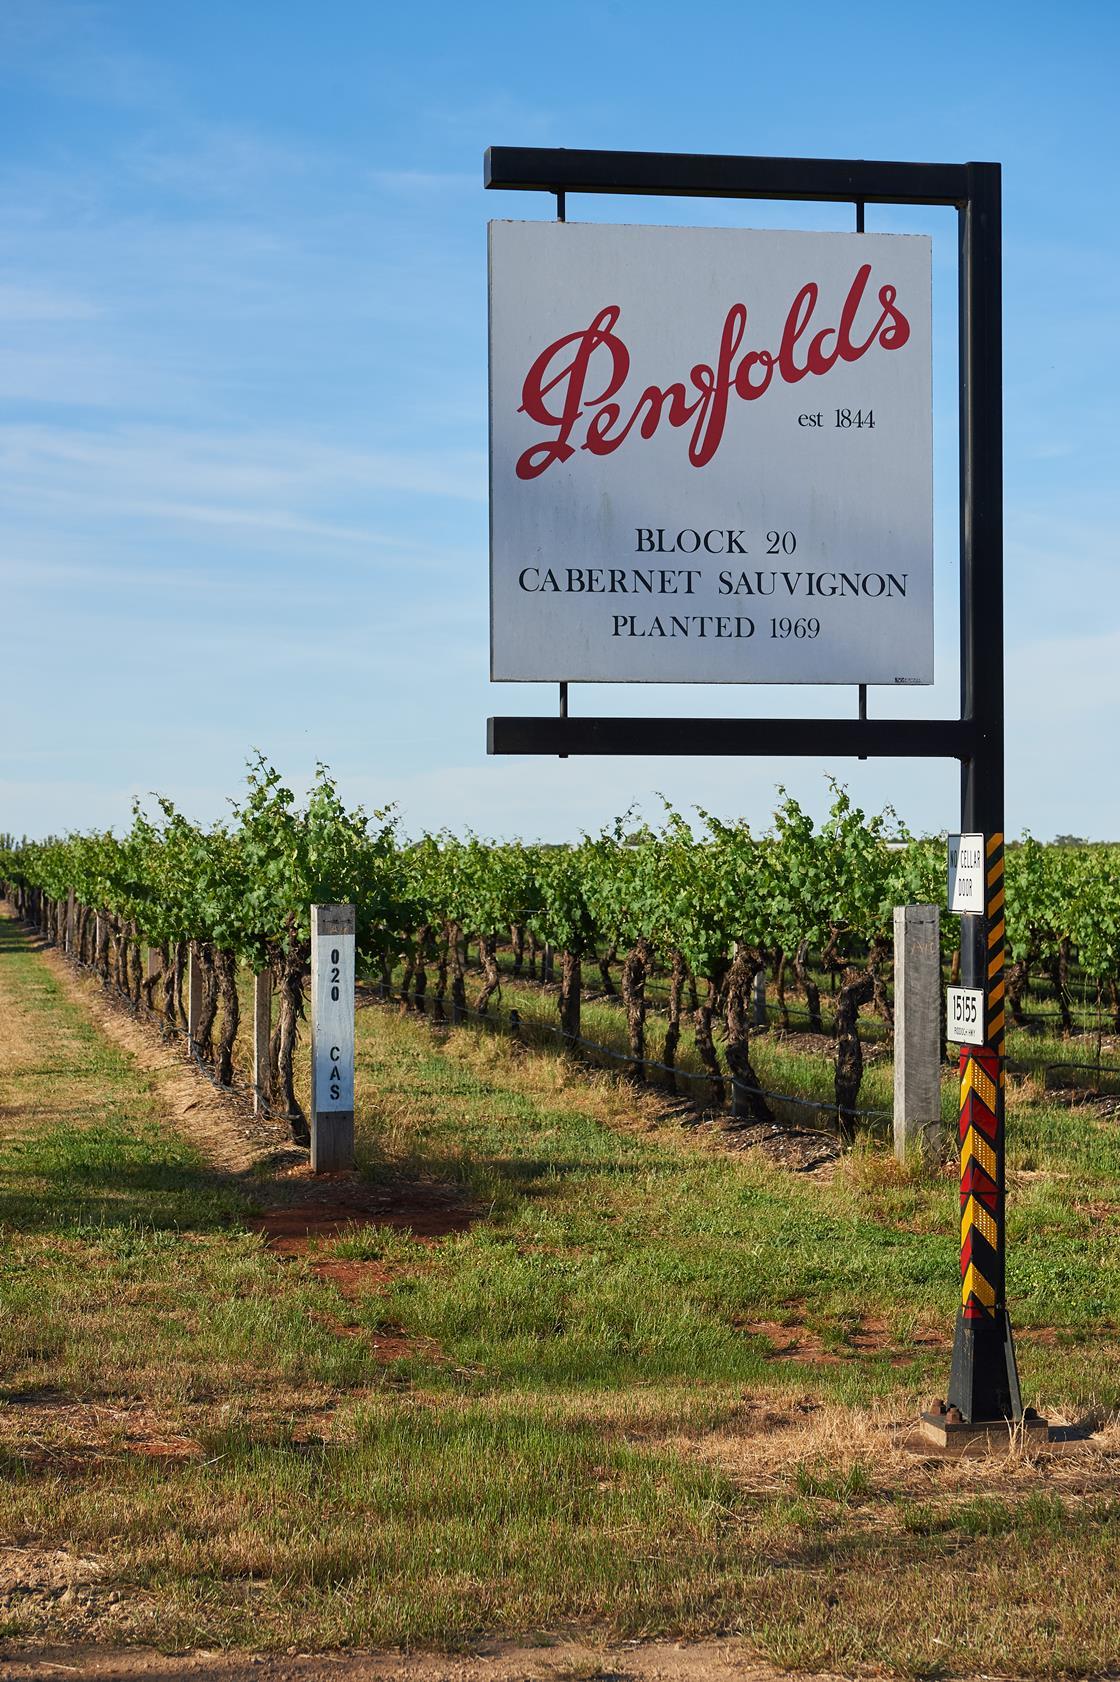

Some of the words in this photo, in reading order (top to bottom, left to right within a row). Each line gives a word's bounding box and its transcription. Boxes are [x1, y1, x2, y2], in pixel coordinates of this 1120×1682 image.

[516, 265, 910, 480] Penfolds
[797, 412, 824, 428] est
[835, 409, 877, 429] 1844
[635, 528, 749, 555] BLOCK
[766, 530, 798, 556] 20
[518, 567, 703, 595] CABERNET
[717, 571, 909, 598] SAUVIGNON
[611, 615, 756, 639] PLANTED
[770, 617, 822, 639] 1969
[950, 850, 958, 869] NO
[960, 850, 981, 869] CELLAR
[958, 878, 973, 897] DOOR
[953, 994, 977, 1023] 15155
[329, 1046, 342, 1101] CAS
